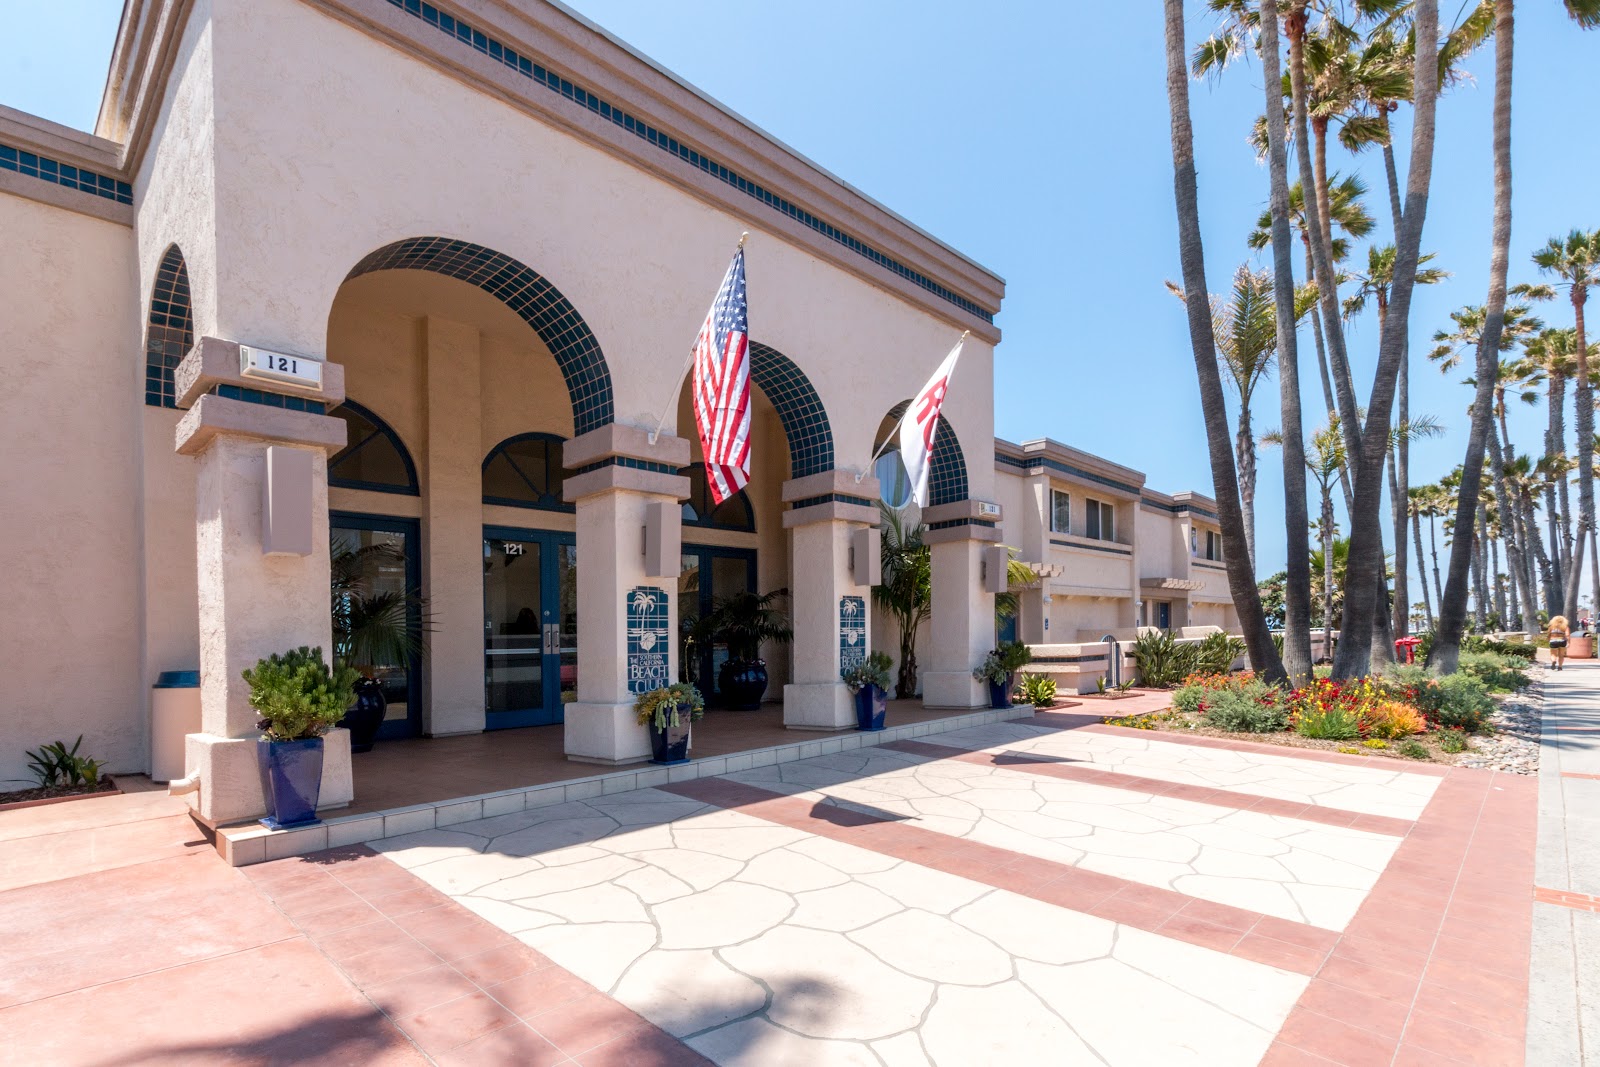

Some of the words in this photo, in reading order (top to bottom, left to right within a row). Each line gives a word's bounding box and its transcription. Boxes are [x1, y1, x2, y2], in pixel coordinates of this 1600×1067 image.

[268, 355, 297, 374] 121
[503, 543, 523, 555] 121
[631, 664, 666, 679] BEACH
[635, 678, 664, 694] CLUB
